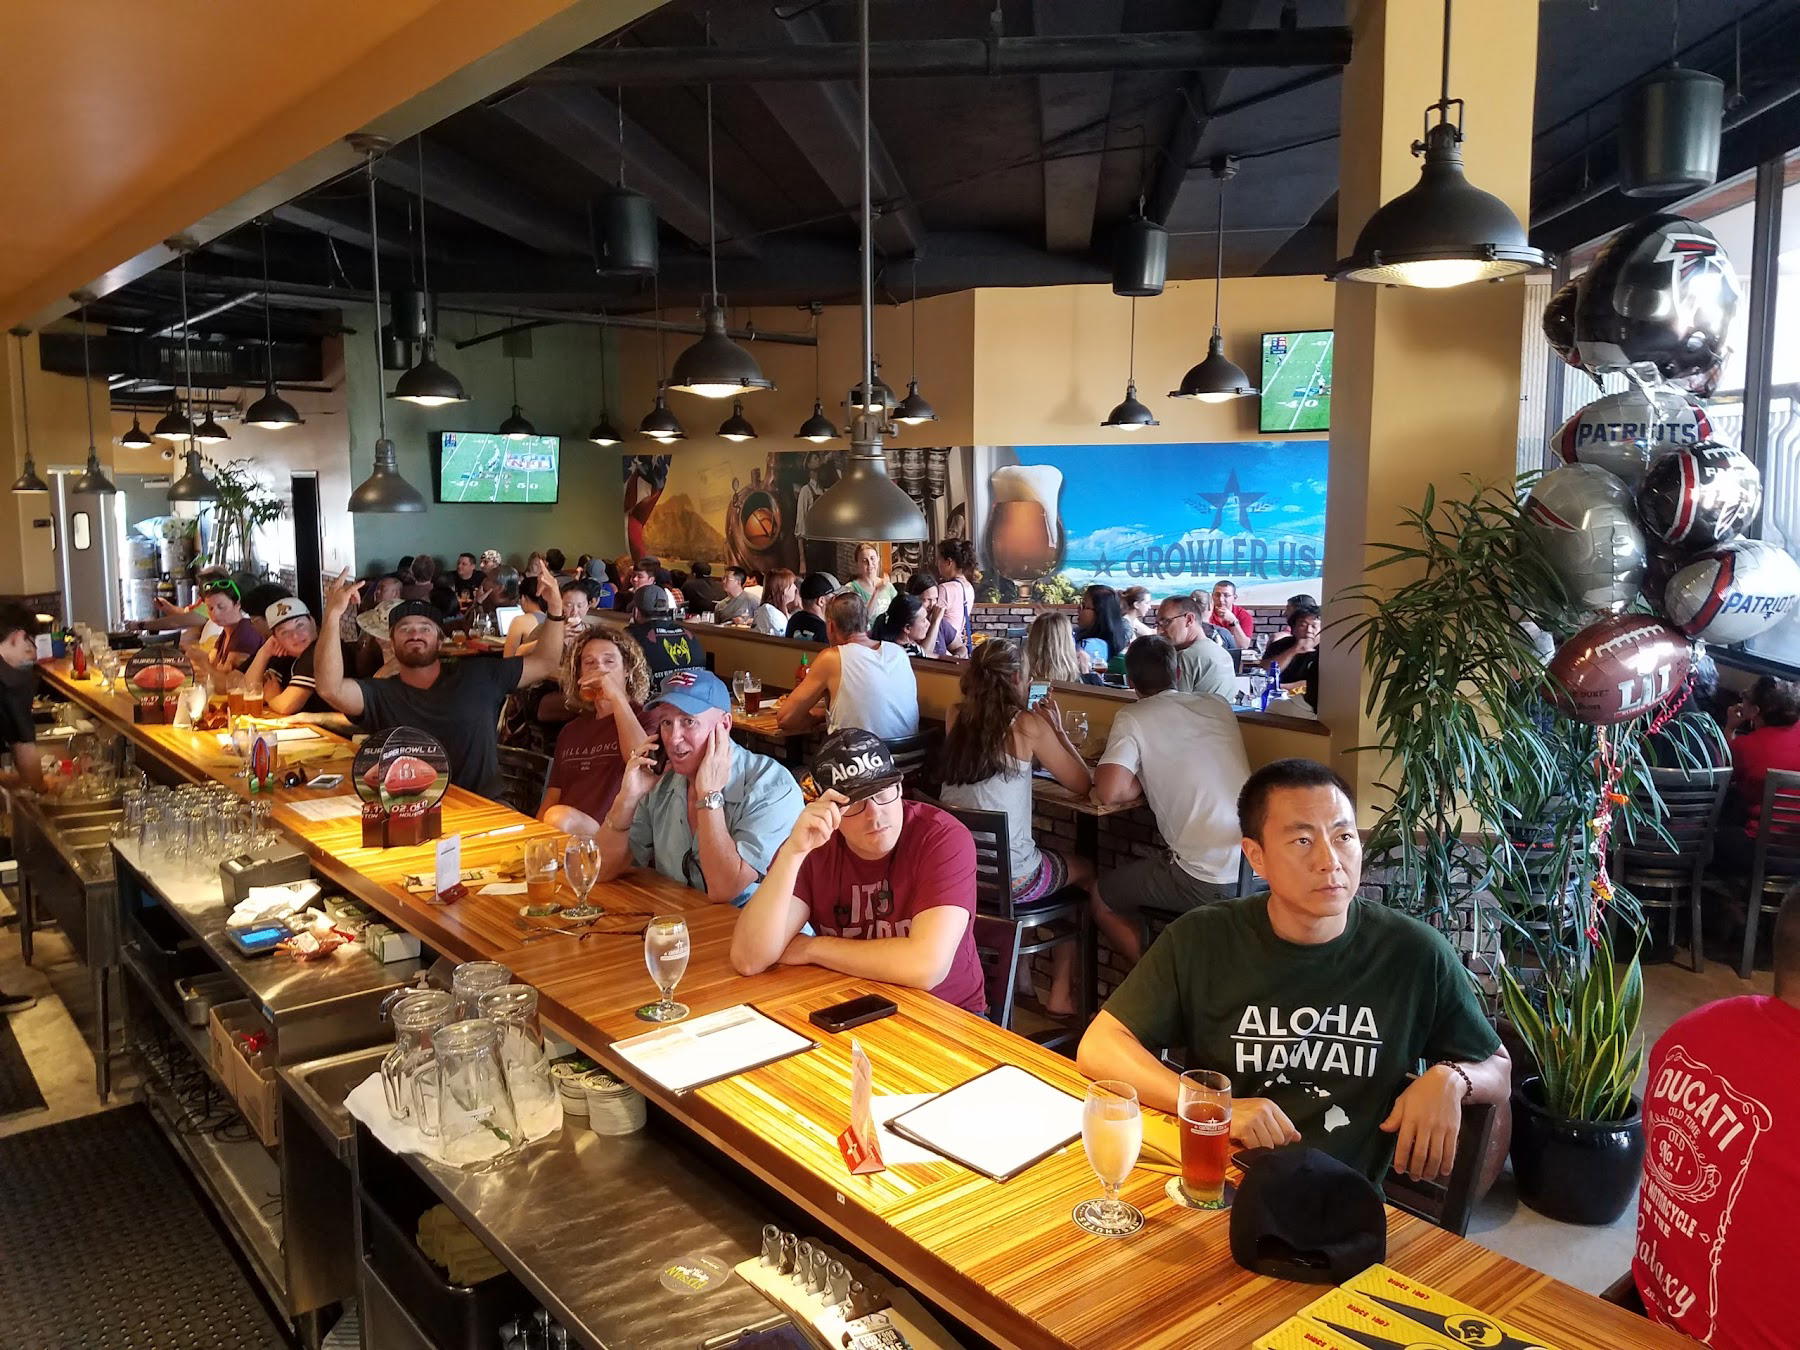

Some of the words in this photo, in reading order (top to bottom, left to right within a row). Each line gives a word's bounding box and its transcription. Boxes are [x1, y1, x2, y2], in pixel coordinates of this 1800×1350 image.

[1578, 423, 1697, 447] PATRIOTS
[1125, 538, 1269, 580] GROWLER
[1278, 540, 1322, 580] US
[1237, 1004, 1379, 1039] ALOHA
[1235, 1039, 1378, 1078] HAWAII
[1653, 1068, 1745, 1152] DUCATI
[1668, 1106, 1685, 1120] OLD
[1684, 1114, 1701, 1139] TIME
[1668, 1130, 1686, 1151] OLD
[1643, 1197, 1653, 1216] IN
[1653, 1211, 1672, 1239] THE
[1648, 1179, 1698, 1239] MOTORCYCLE
[1636, 1233, 1697, 1318] alaxy
